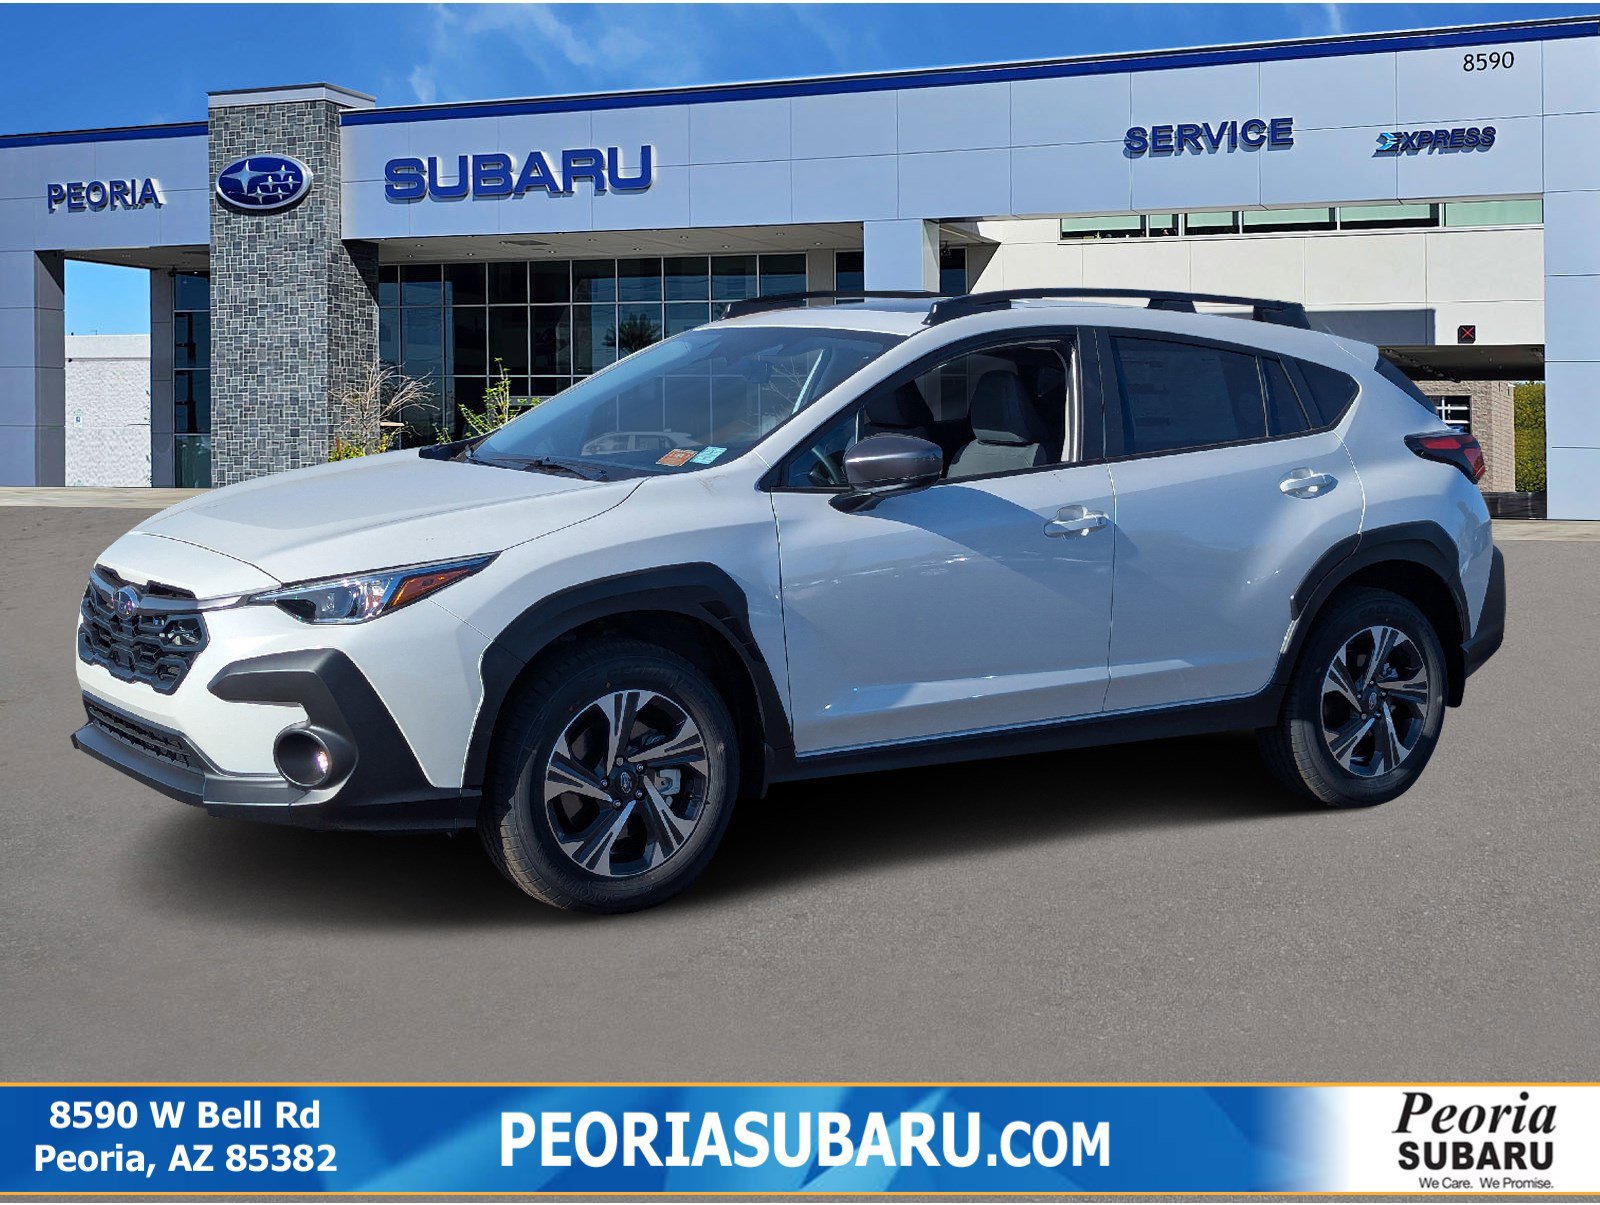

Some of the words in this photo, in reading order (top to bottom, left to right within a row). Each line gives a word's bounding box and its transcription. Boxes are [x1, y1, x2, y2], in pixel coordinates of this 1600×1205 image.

[1463, 51, 1515, 72] 8590
[1125, 117, 1293, 156] SERVICE
[1374, 126, 1495, 155] EXPRESS
[384, 145, 652, 202] SUBARU
[48, 178, 161, 211] PEORIA
